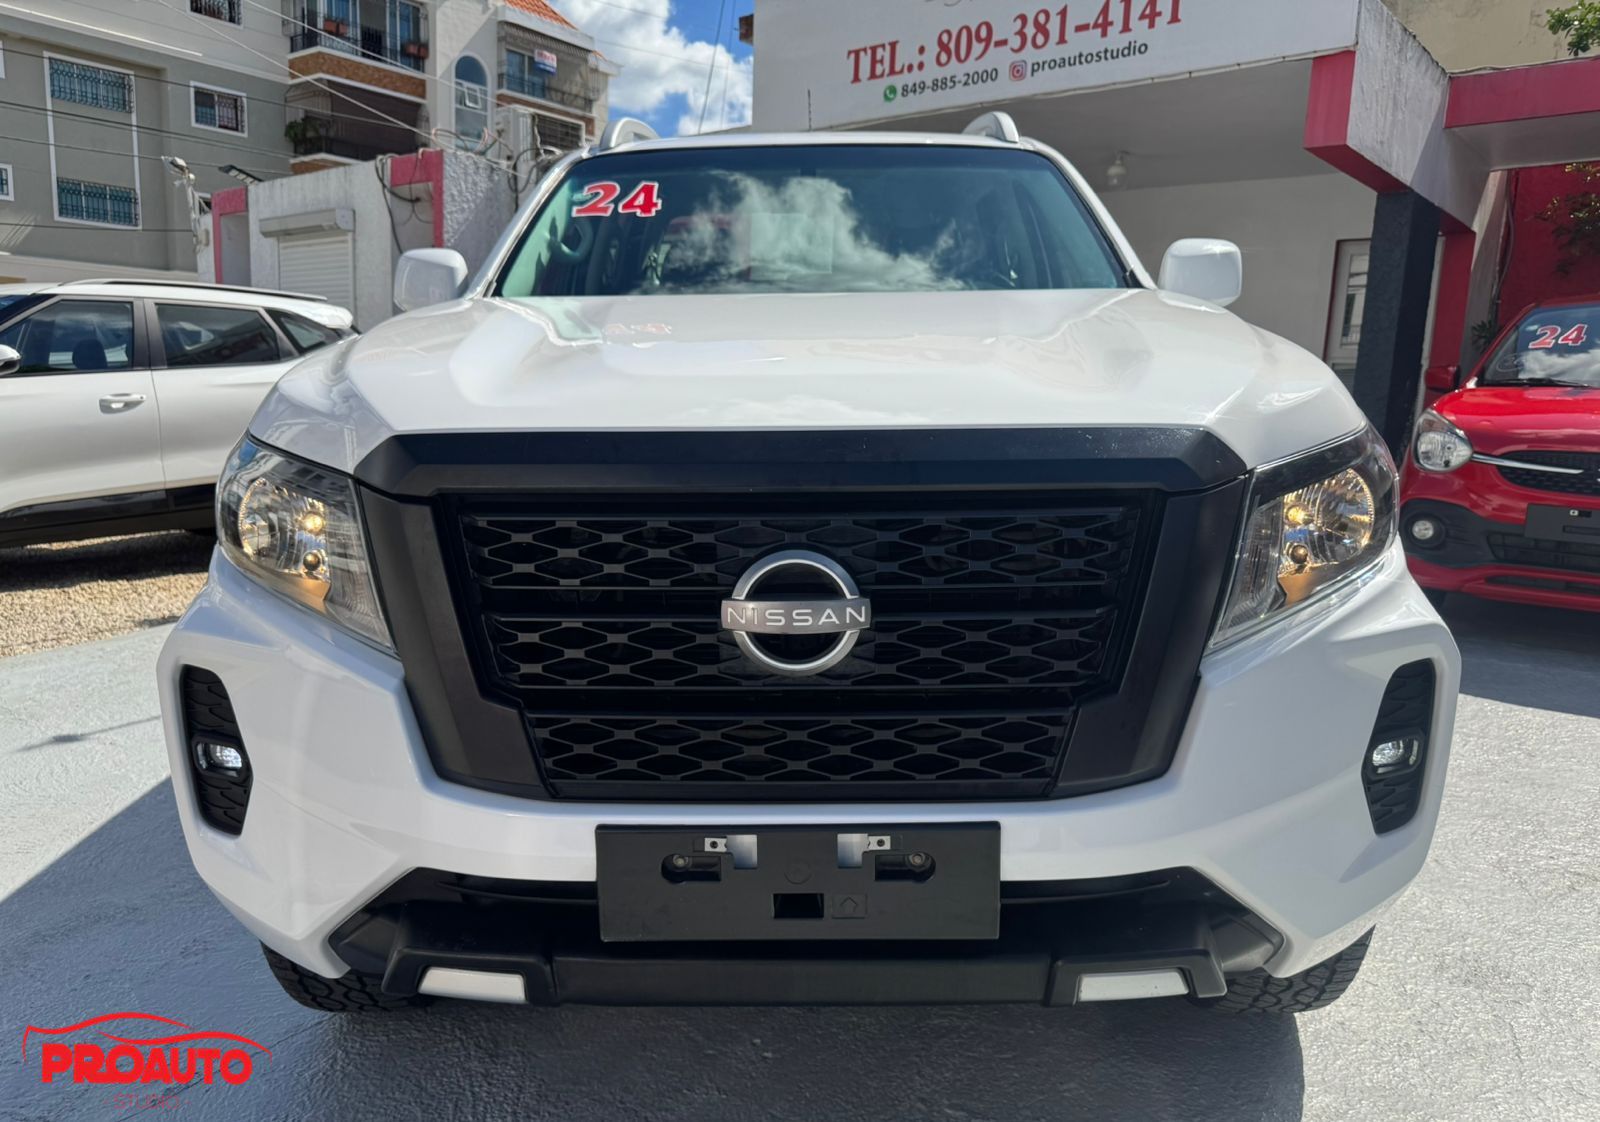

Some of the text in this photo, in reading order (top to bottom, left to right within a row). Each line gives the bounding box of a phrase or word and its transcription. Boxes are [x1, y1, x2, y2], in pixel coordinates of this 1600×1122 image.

[847, 0, 1183, 84] TEL.: 809-381-4141
[900, 40, 1149, 98] 849-885-2000 proautostudio
[571, 181, 663, 217] 24
[1528, 323, 1588, 349] 24
[727, 606, 866, 627] NISSAN
